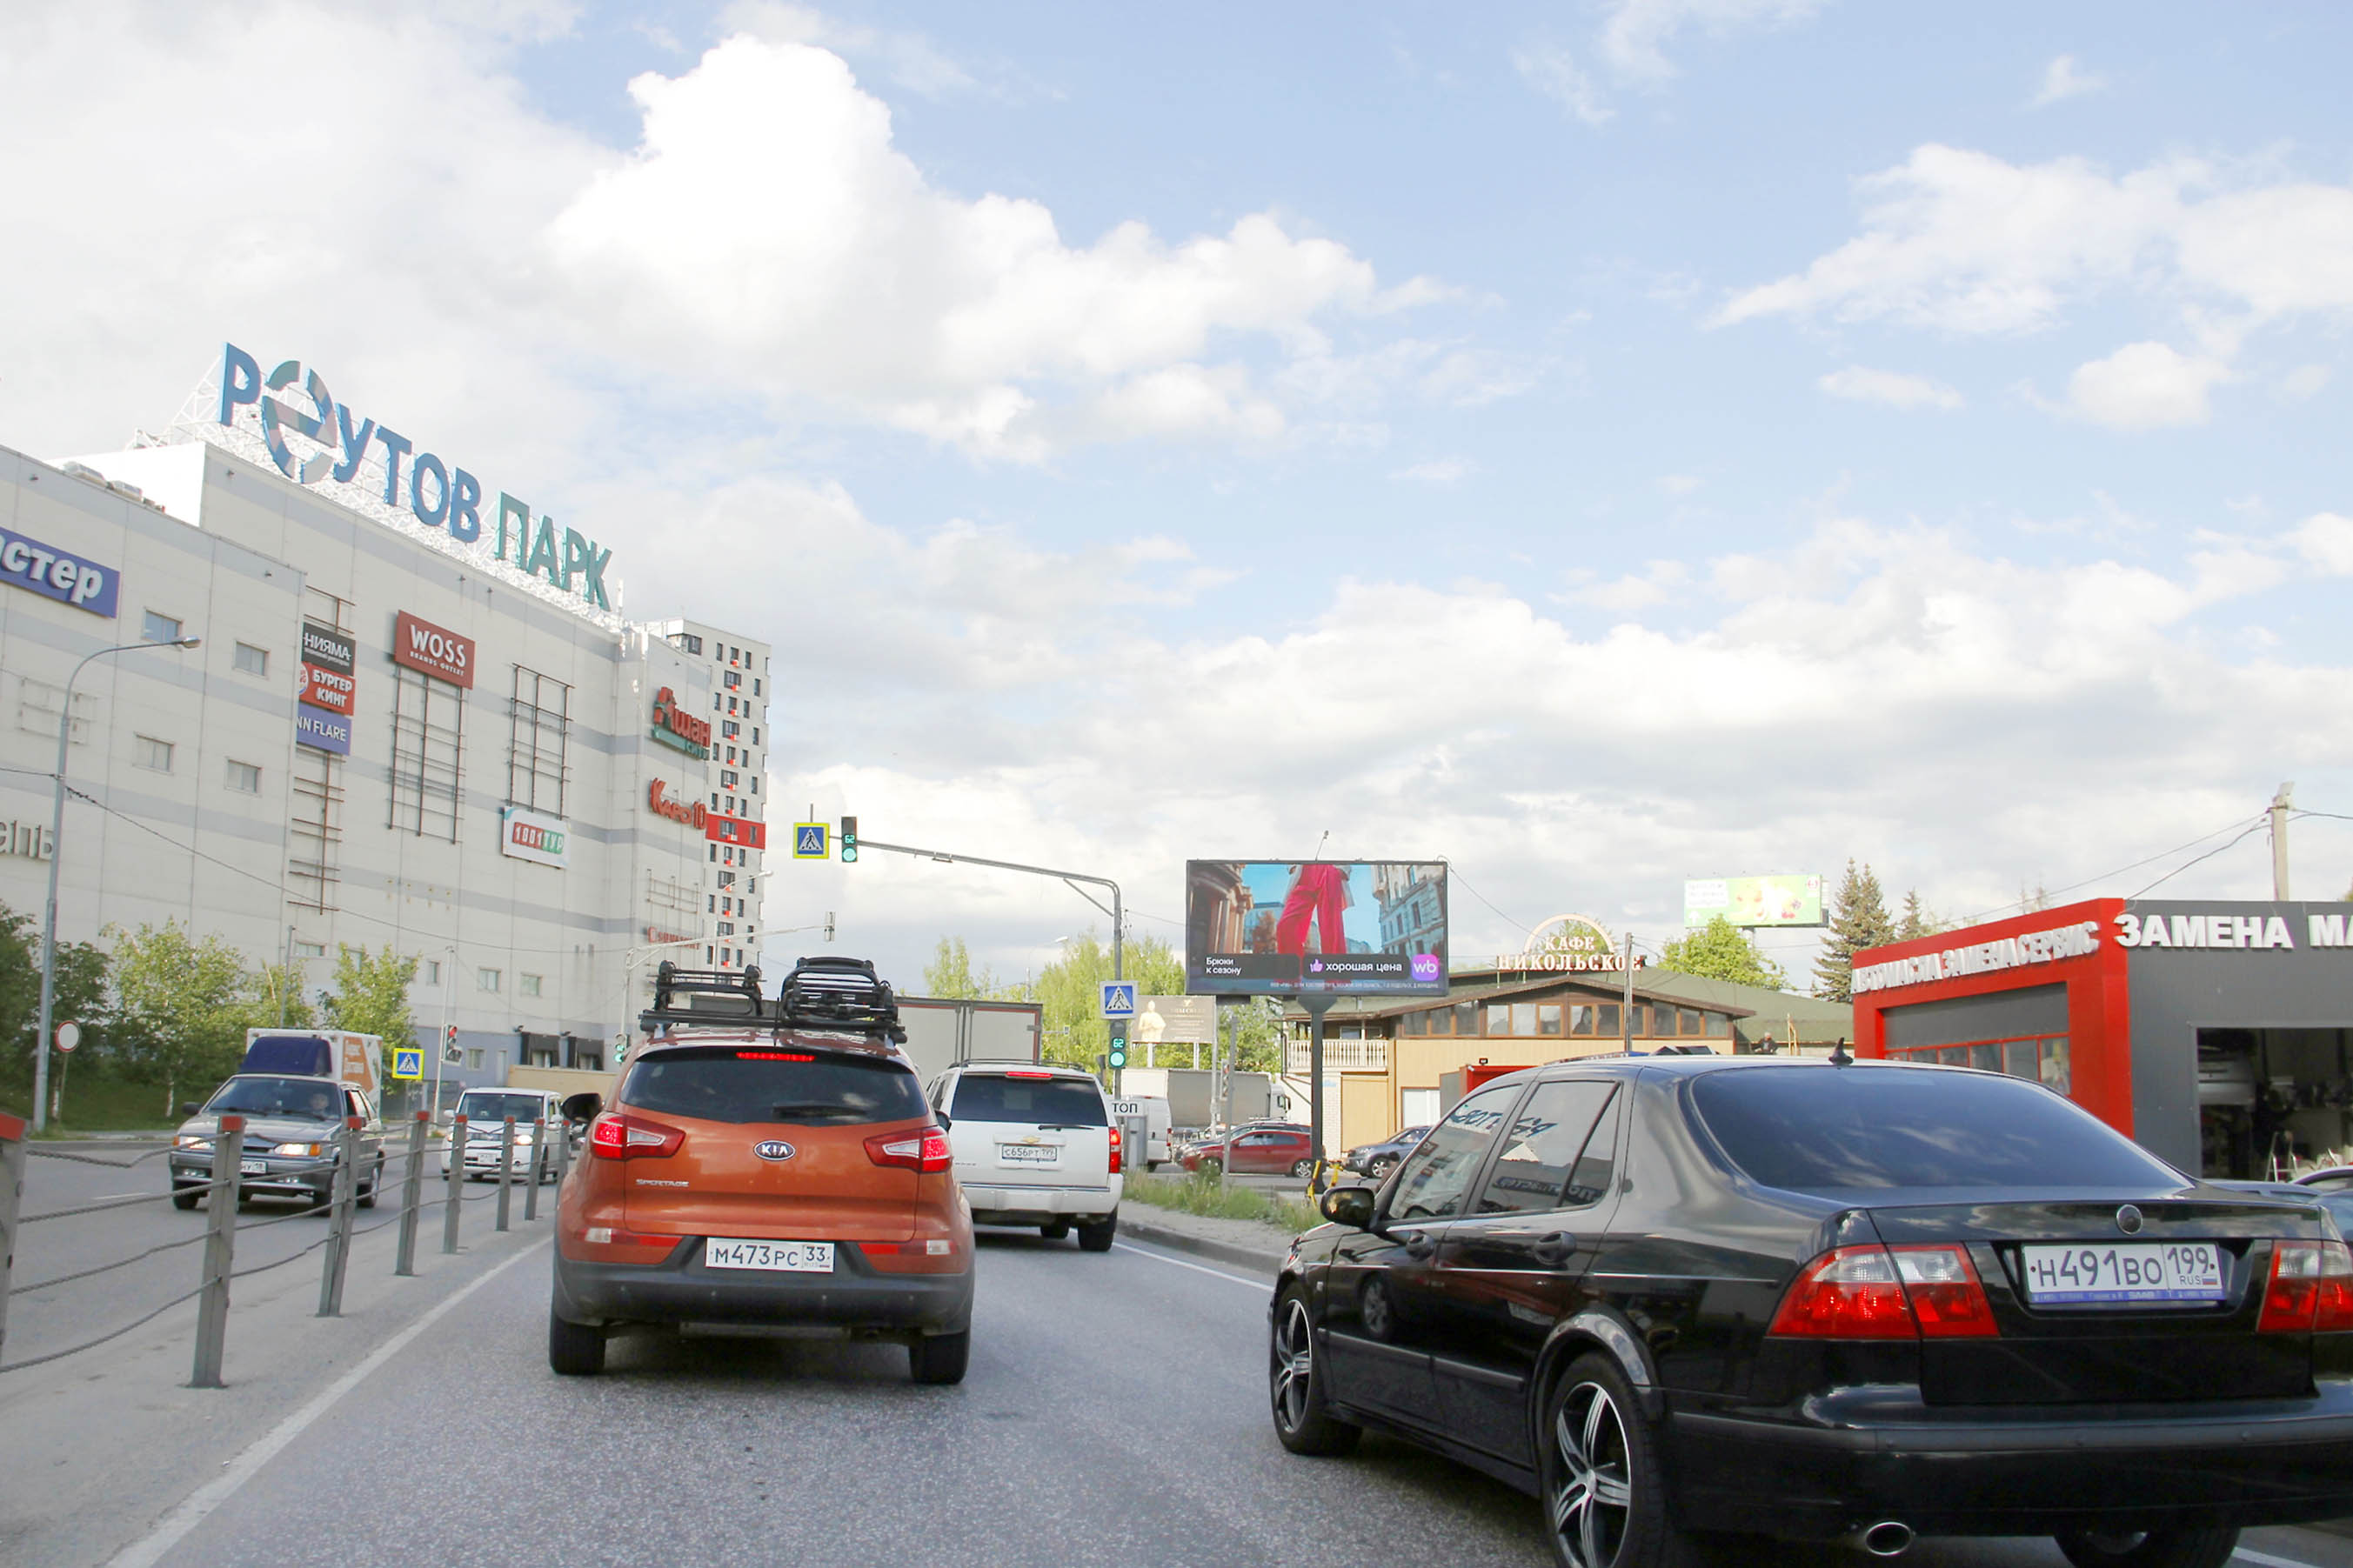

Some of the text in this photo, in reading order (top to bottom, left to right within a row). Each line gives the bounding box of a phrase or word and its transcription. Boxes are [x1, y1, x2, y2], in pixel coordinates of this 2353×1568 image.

[495, 491, 613, 611] ПАРК
[0, 534, 104, 604] стер
[410, 624, 467, 668] WOSS
[312, 669, 353, 692] БУРГЕР
[316, 687, 347, 707] КИНГ
[312, 720, 347, 742] FLARE
[2114, 914, 2353, 949] ЗАМЕНА М
[1544, 936, 1595, 951] КАФЕ
[1941, 937, 2020, 978] ЗАМЕНА
[2017, 921, 2100, 965] СЕРВИС
[1206, 957, 1233, 966] Брюки
[1326, 963, 1402, 972] хорошая цена
[1414, 959, 1437, 973] wb
[1497, 953, 1642, 972] НИКОЛЬСКОЕ
[1213, 967, 1241, 976] сезону
[1113, 1038, 1124, 1048] 62
[1112, 1103, 1138, 1113] ТОП
[761, 1144, 788, 1156] KIA
[715, 1244, 826, 1266] М473РС 33
[2037, 1247, 2209, 1287] Н491ВО 199
[2179, 1275, 2202, 1285] RUS
